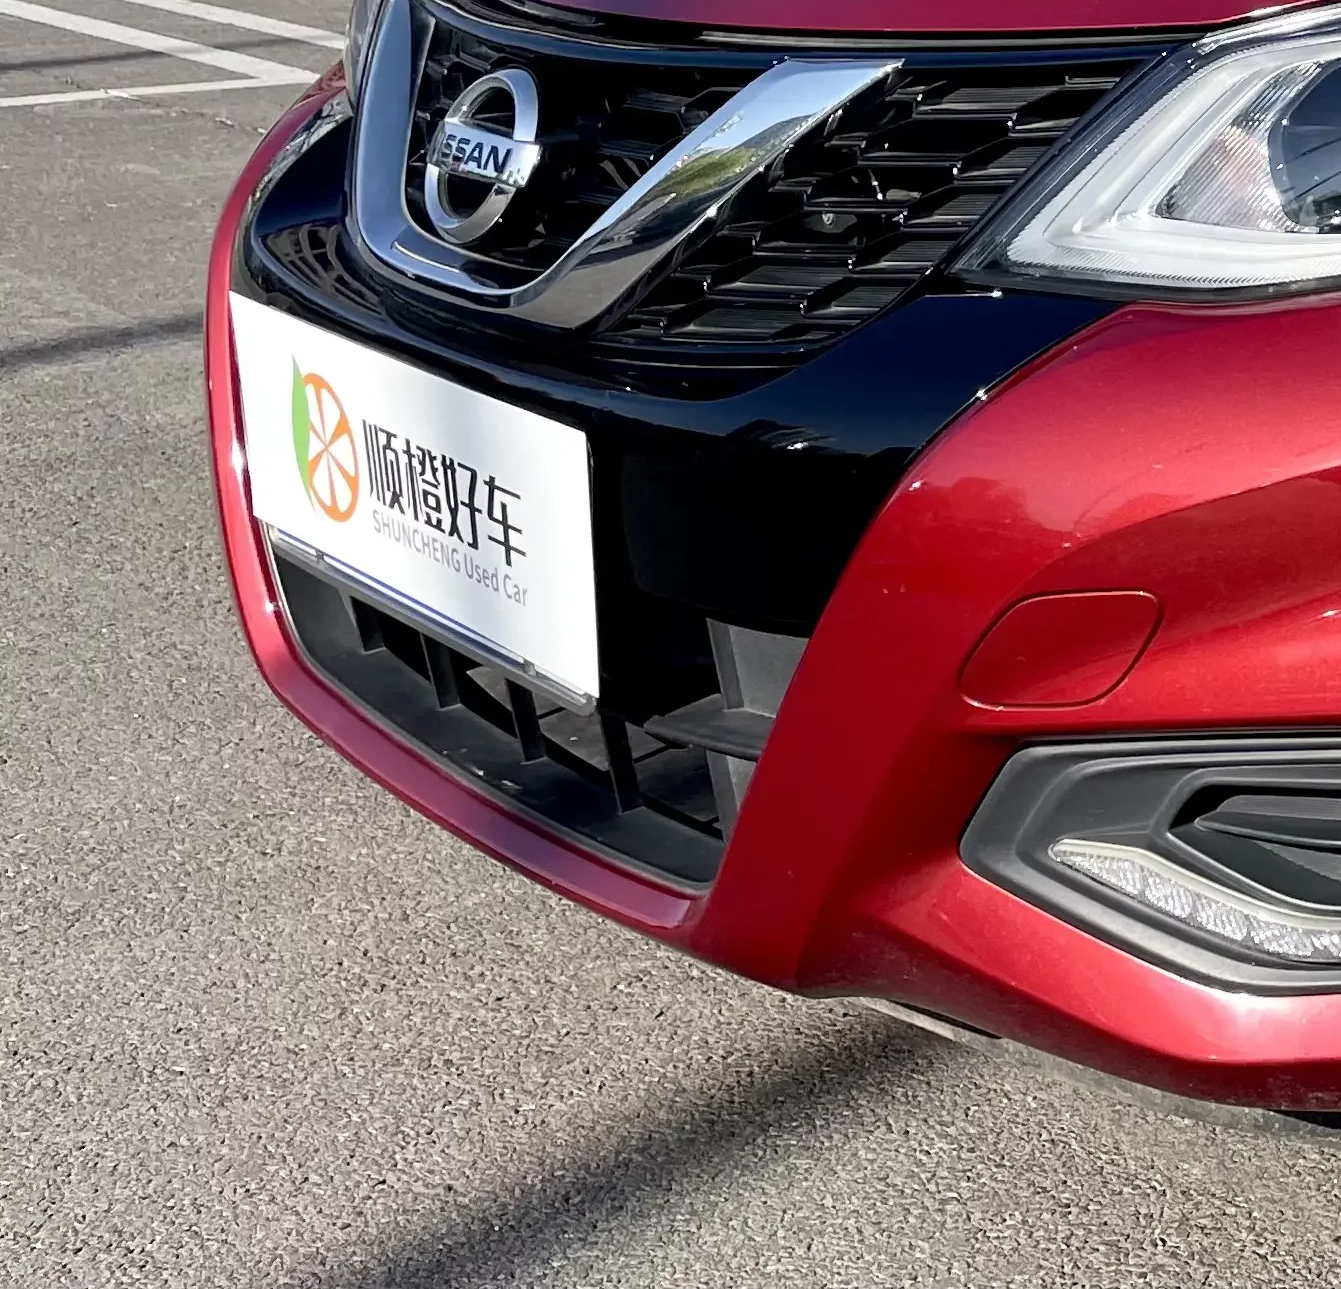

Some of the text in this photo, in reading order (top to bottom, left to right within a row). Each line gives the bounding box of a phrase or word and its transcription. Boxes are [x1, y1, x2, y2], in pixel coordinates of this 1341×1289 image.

[361, 418, 527, 567] 顺橙好车
[373, 509, 529, 607] SHUNCHENG Used Car
